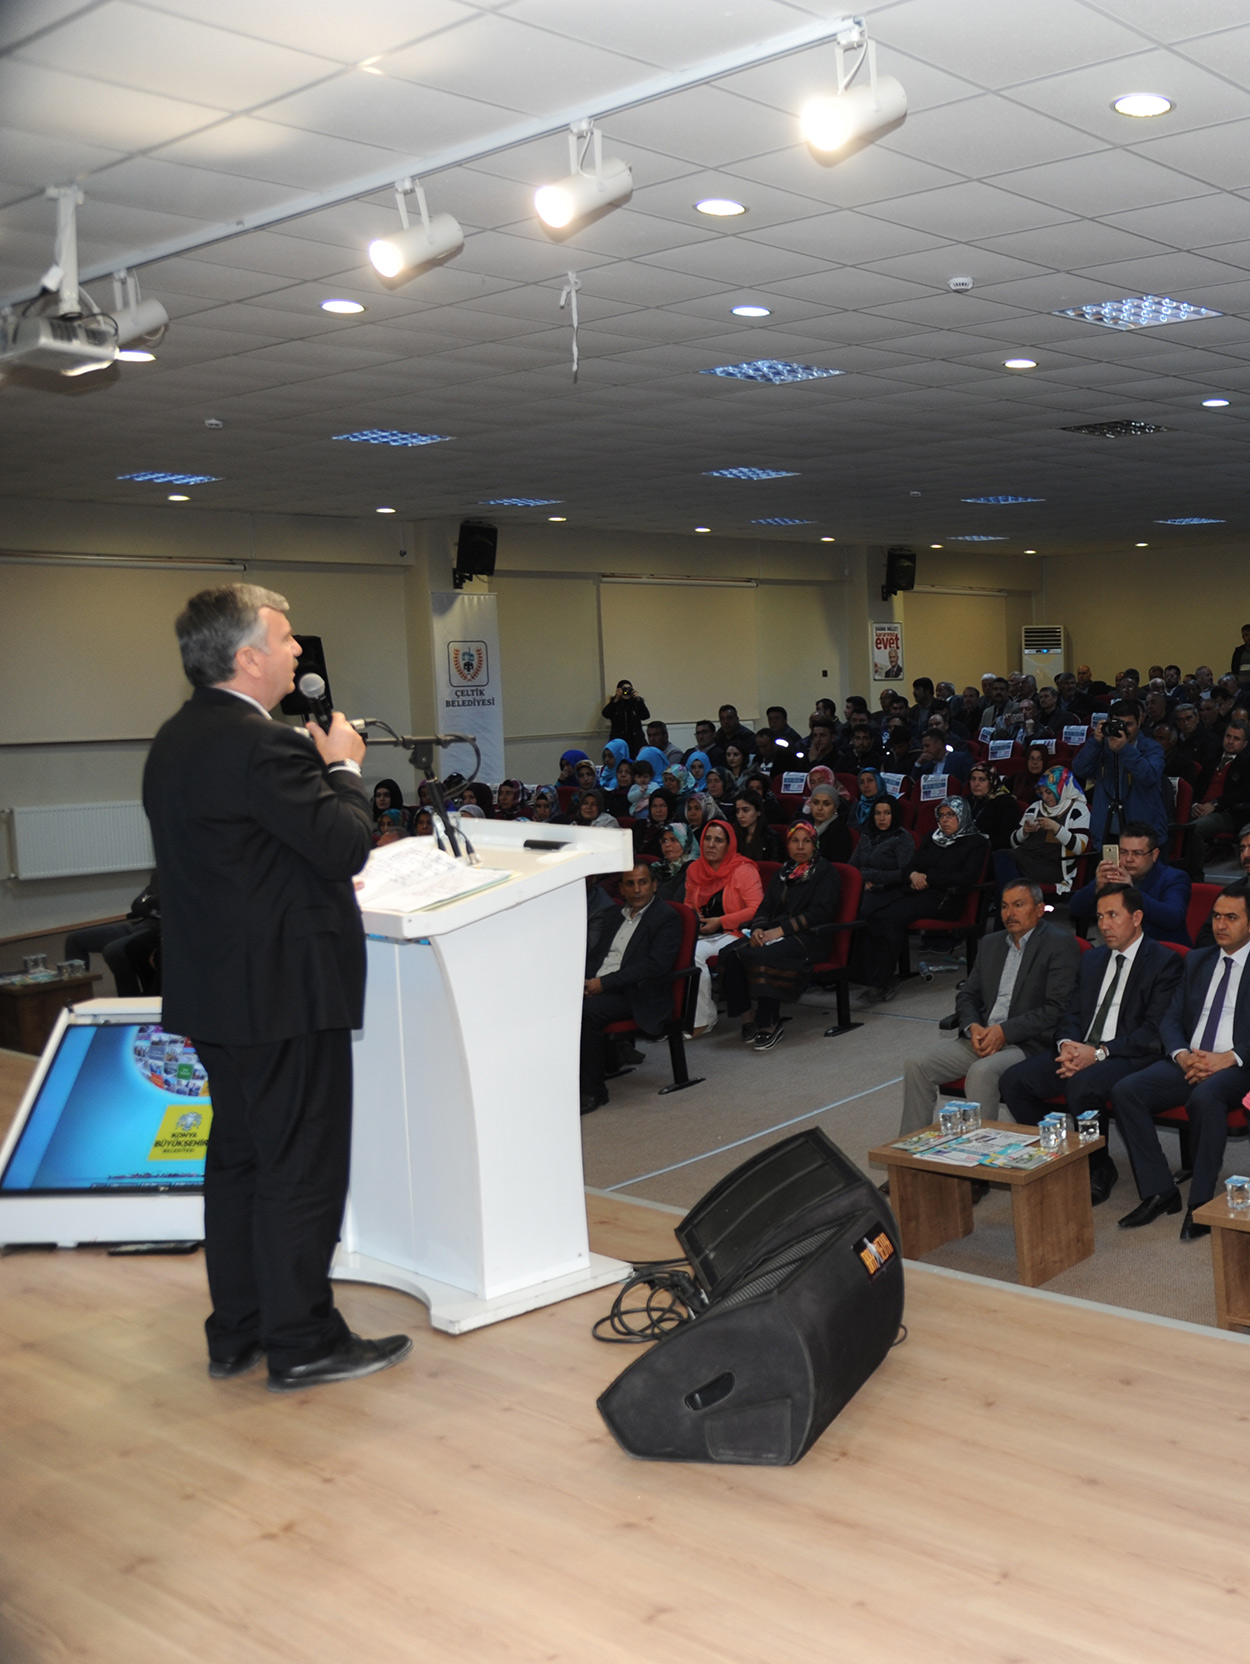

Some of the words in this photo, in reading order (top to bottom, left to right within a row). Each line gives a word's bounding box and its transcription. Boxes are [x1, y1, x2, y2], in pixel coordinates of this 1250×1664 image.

[875, 633, 900, 650] evet
[455, 688, 485, 698] ÇELTİK
[445, 697, 495, 707] BELEDİYESİ
